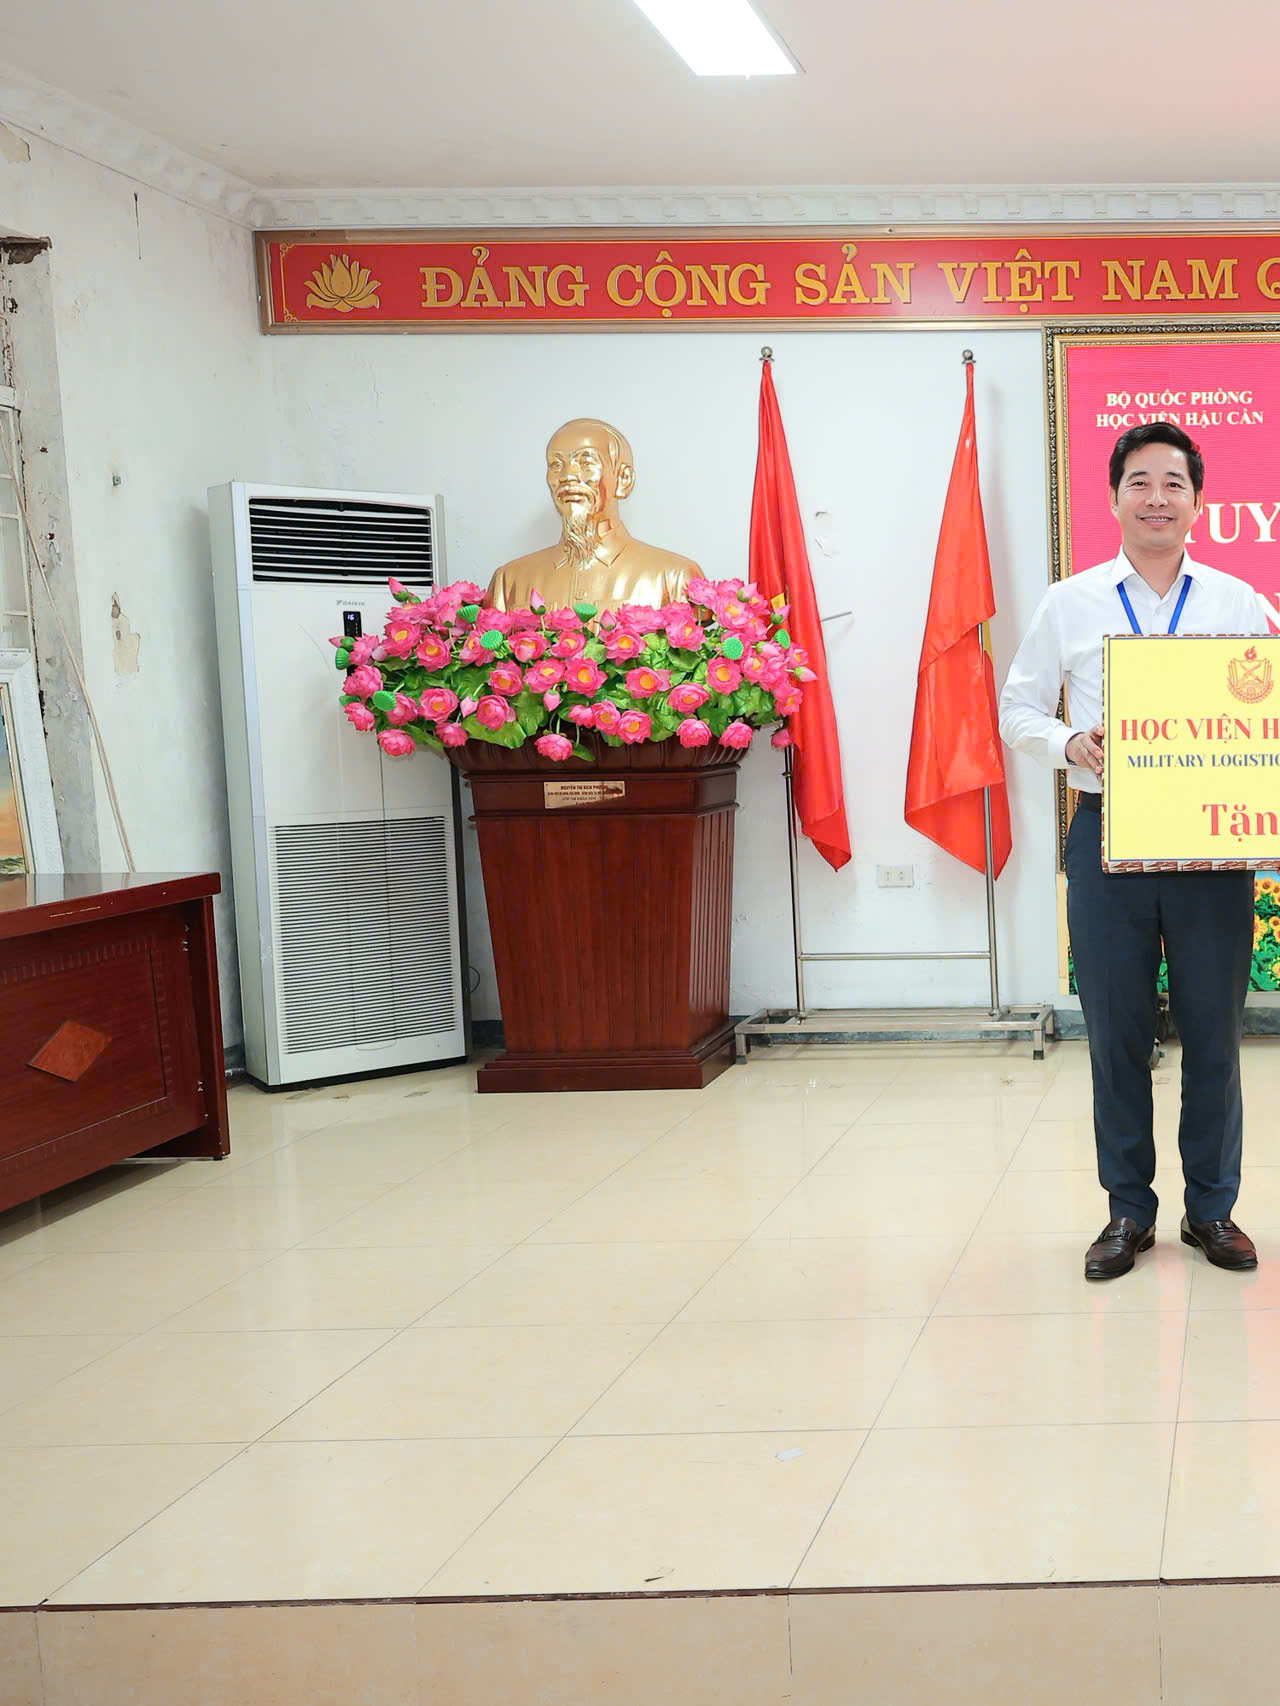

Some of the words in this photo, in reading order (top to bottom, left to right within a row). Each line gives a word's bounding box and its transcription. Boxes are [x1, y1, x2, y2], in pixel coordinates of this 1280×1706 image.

[419, 245, 590, 308] ĐẢNG
[606, 249, 772, 318] CỘNG
[795, 242, 916, 307] SẢN
[938, 248, 1080, 313] VIỆT
[1101, 257, 1240, 301] NAM
[1106, 391, 1131, 409] BỘ
[1135, 387, 1186, 408] QUỐC
[1191, 387, 1254, 406] PHÒNG
[1096, 413, 1135, 430] HỌC
[1185, 409, 1223, 429] HẬU
[1226, 407, 1264, 425] CẦN
[1119, 717, 1178, 745] HỌC
[1185, 713, 1252, 743] VIỆN
[1127, 754, 1206, 769] MILITARY
